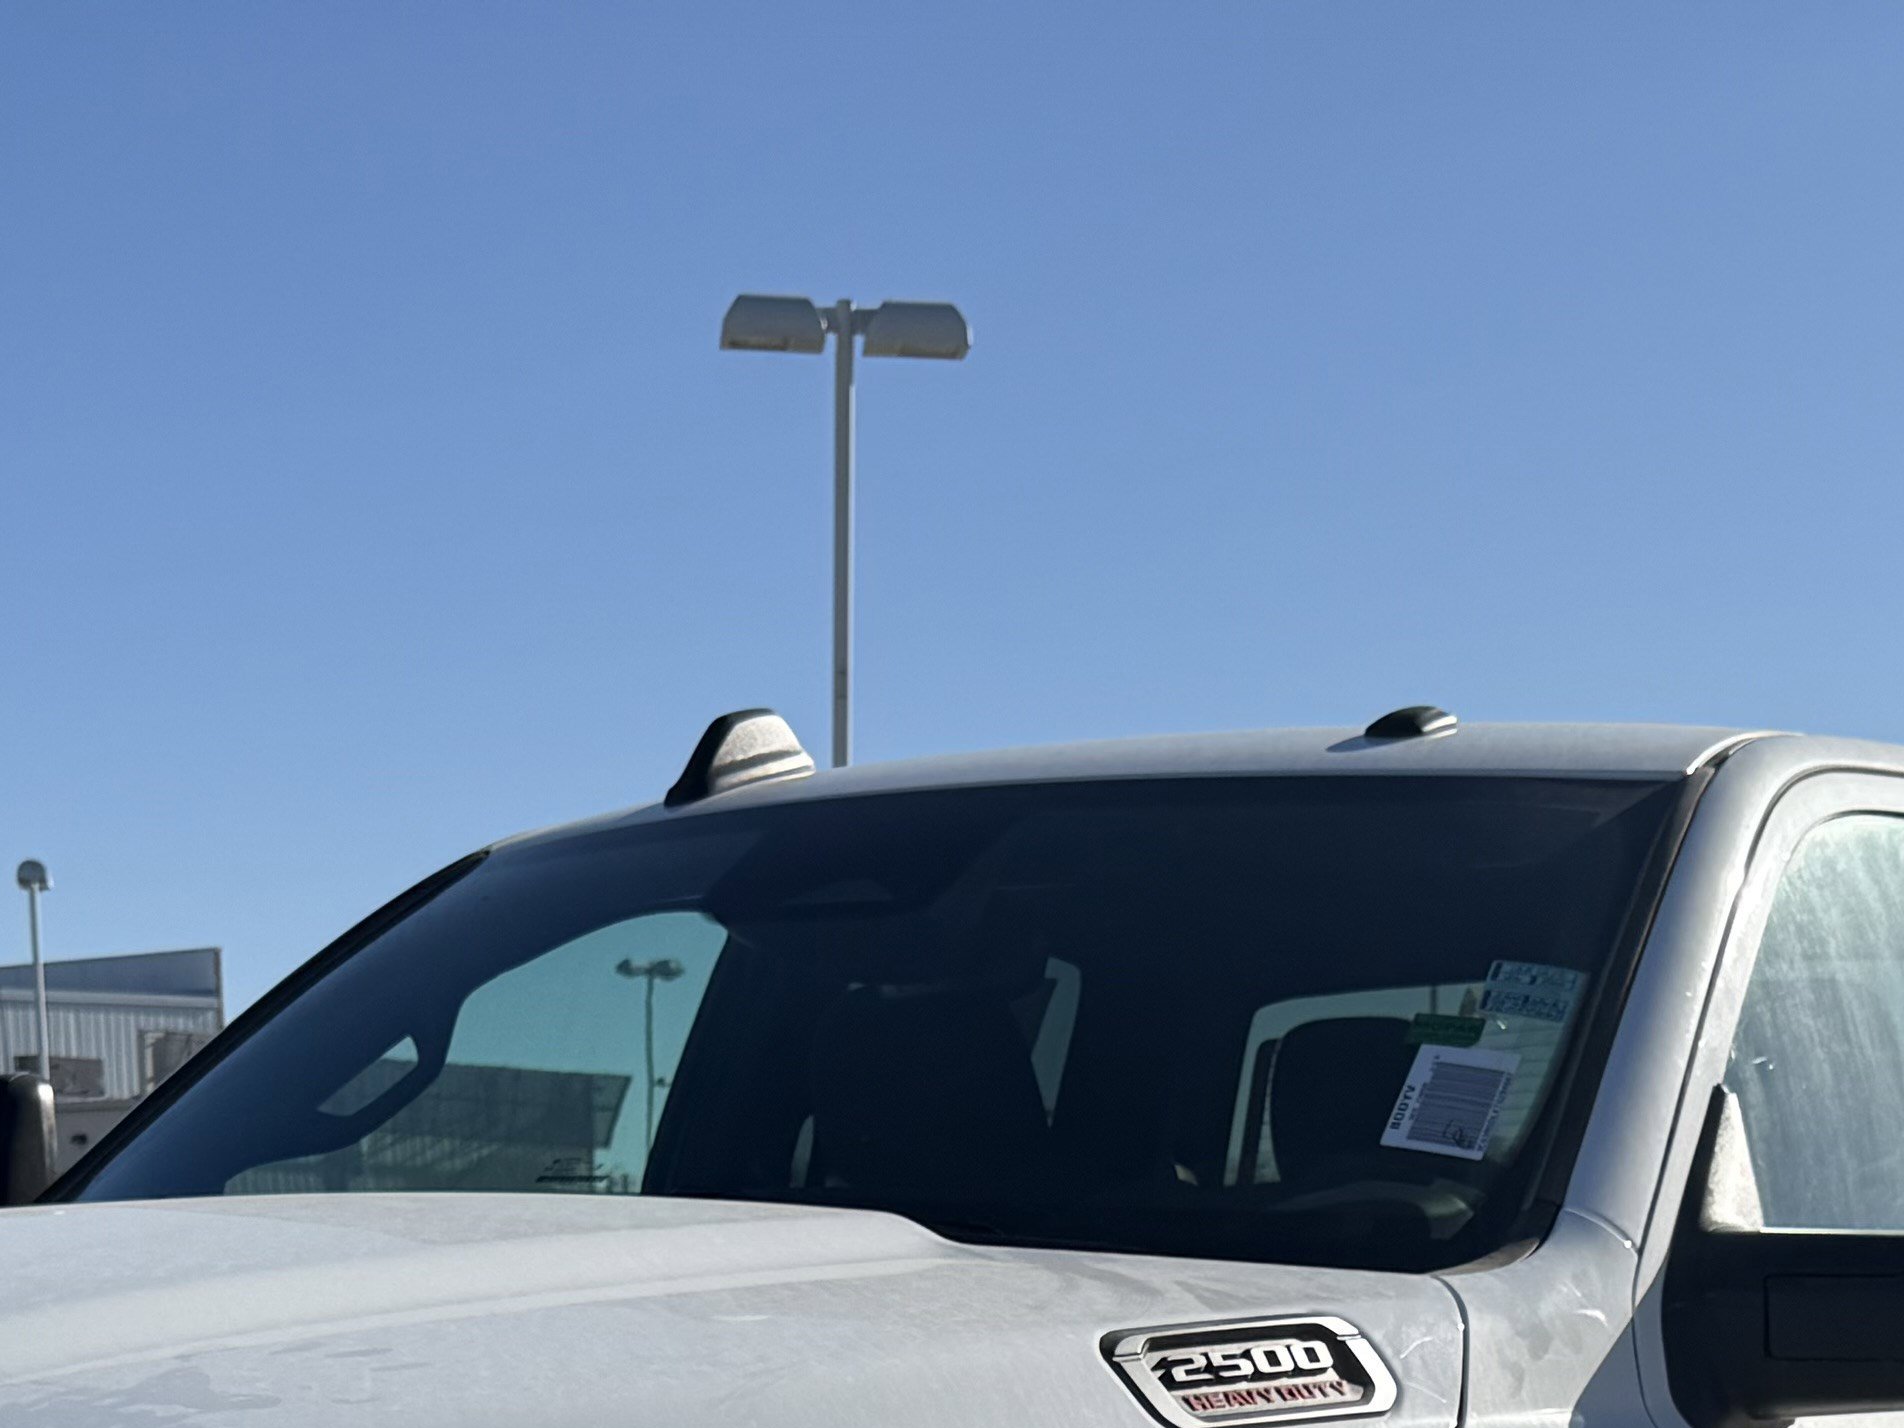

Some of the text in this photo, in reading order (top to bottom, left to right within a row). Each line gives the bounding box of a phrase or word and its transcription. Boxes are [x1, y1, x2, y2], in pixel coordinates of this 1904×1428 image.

[1166, 1340, 1334, 1382] 2500
[1181, 1379, 1347, 1412] HEAVY DUTY
